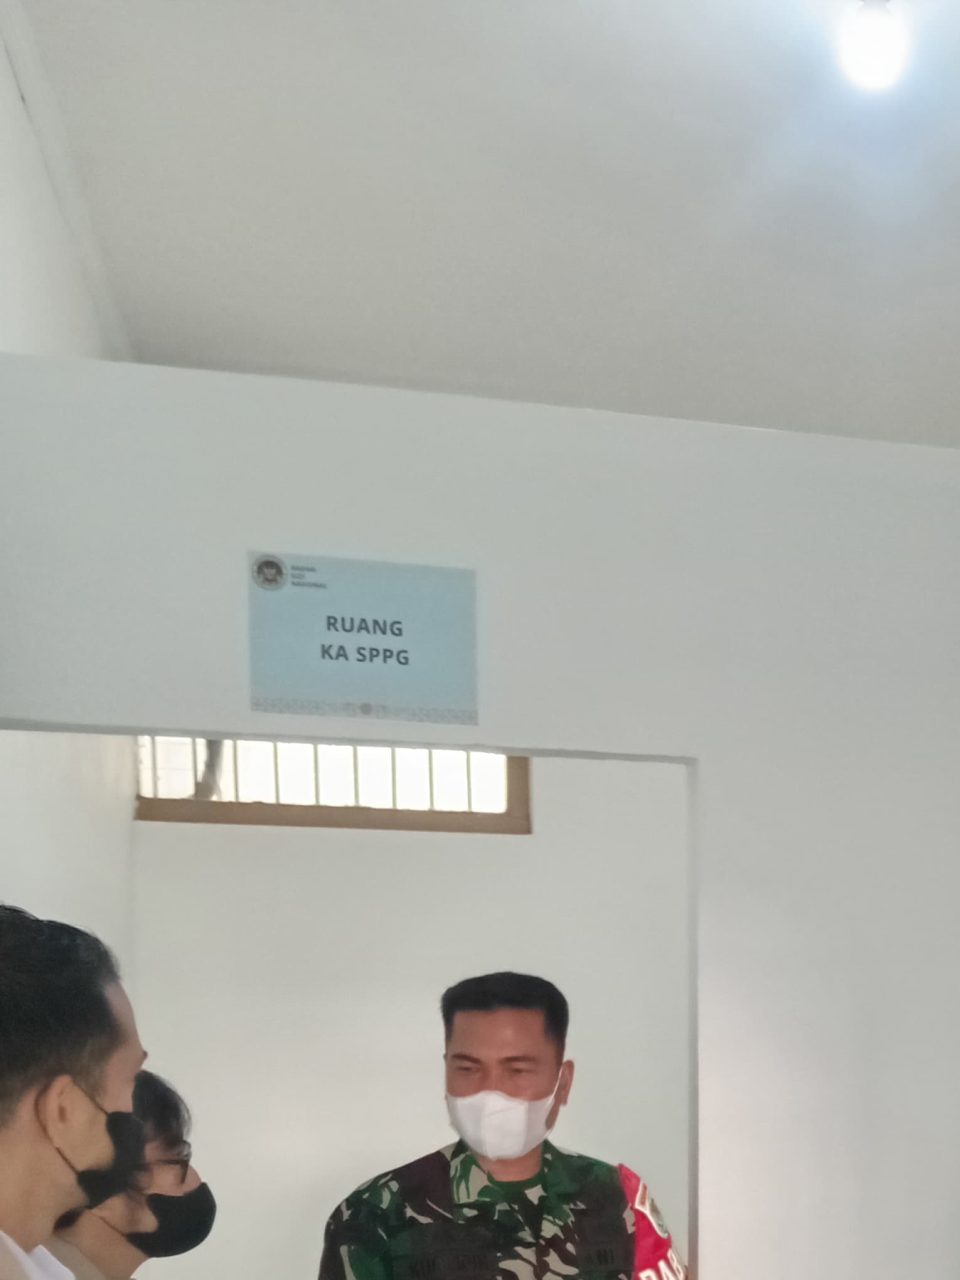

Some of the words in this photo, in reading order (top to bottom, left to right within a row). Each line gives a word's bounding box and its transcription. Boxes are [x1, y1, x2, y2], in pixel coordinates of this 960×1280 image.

[326, 615, 403, 636] RUANG
[320, 643, 349, 661] KA
[356, 646, 409, 665] SPPG
